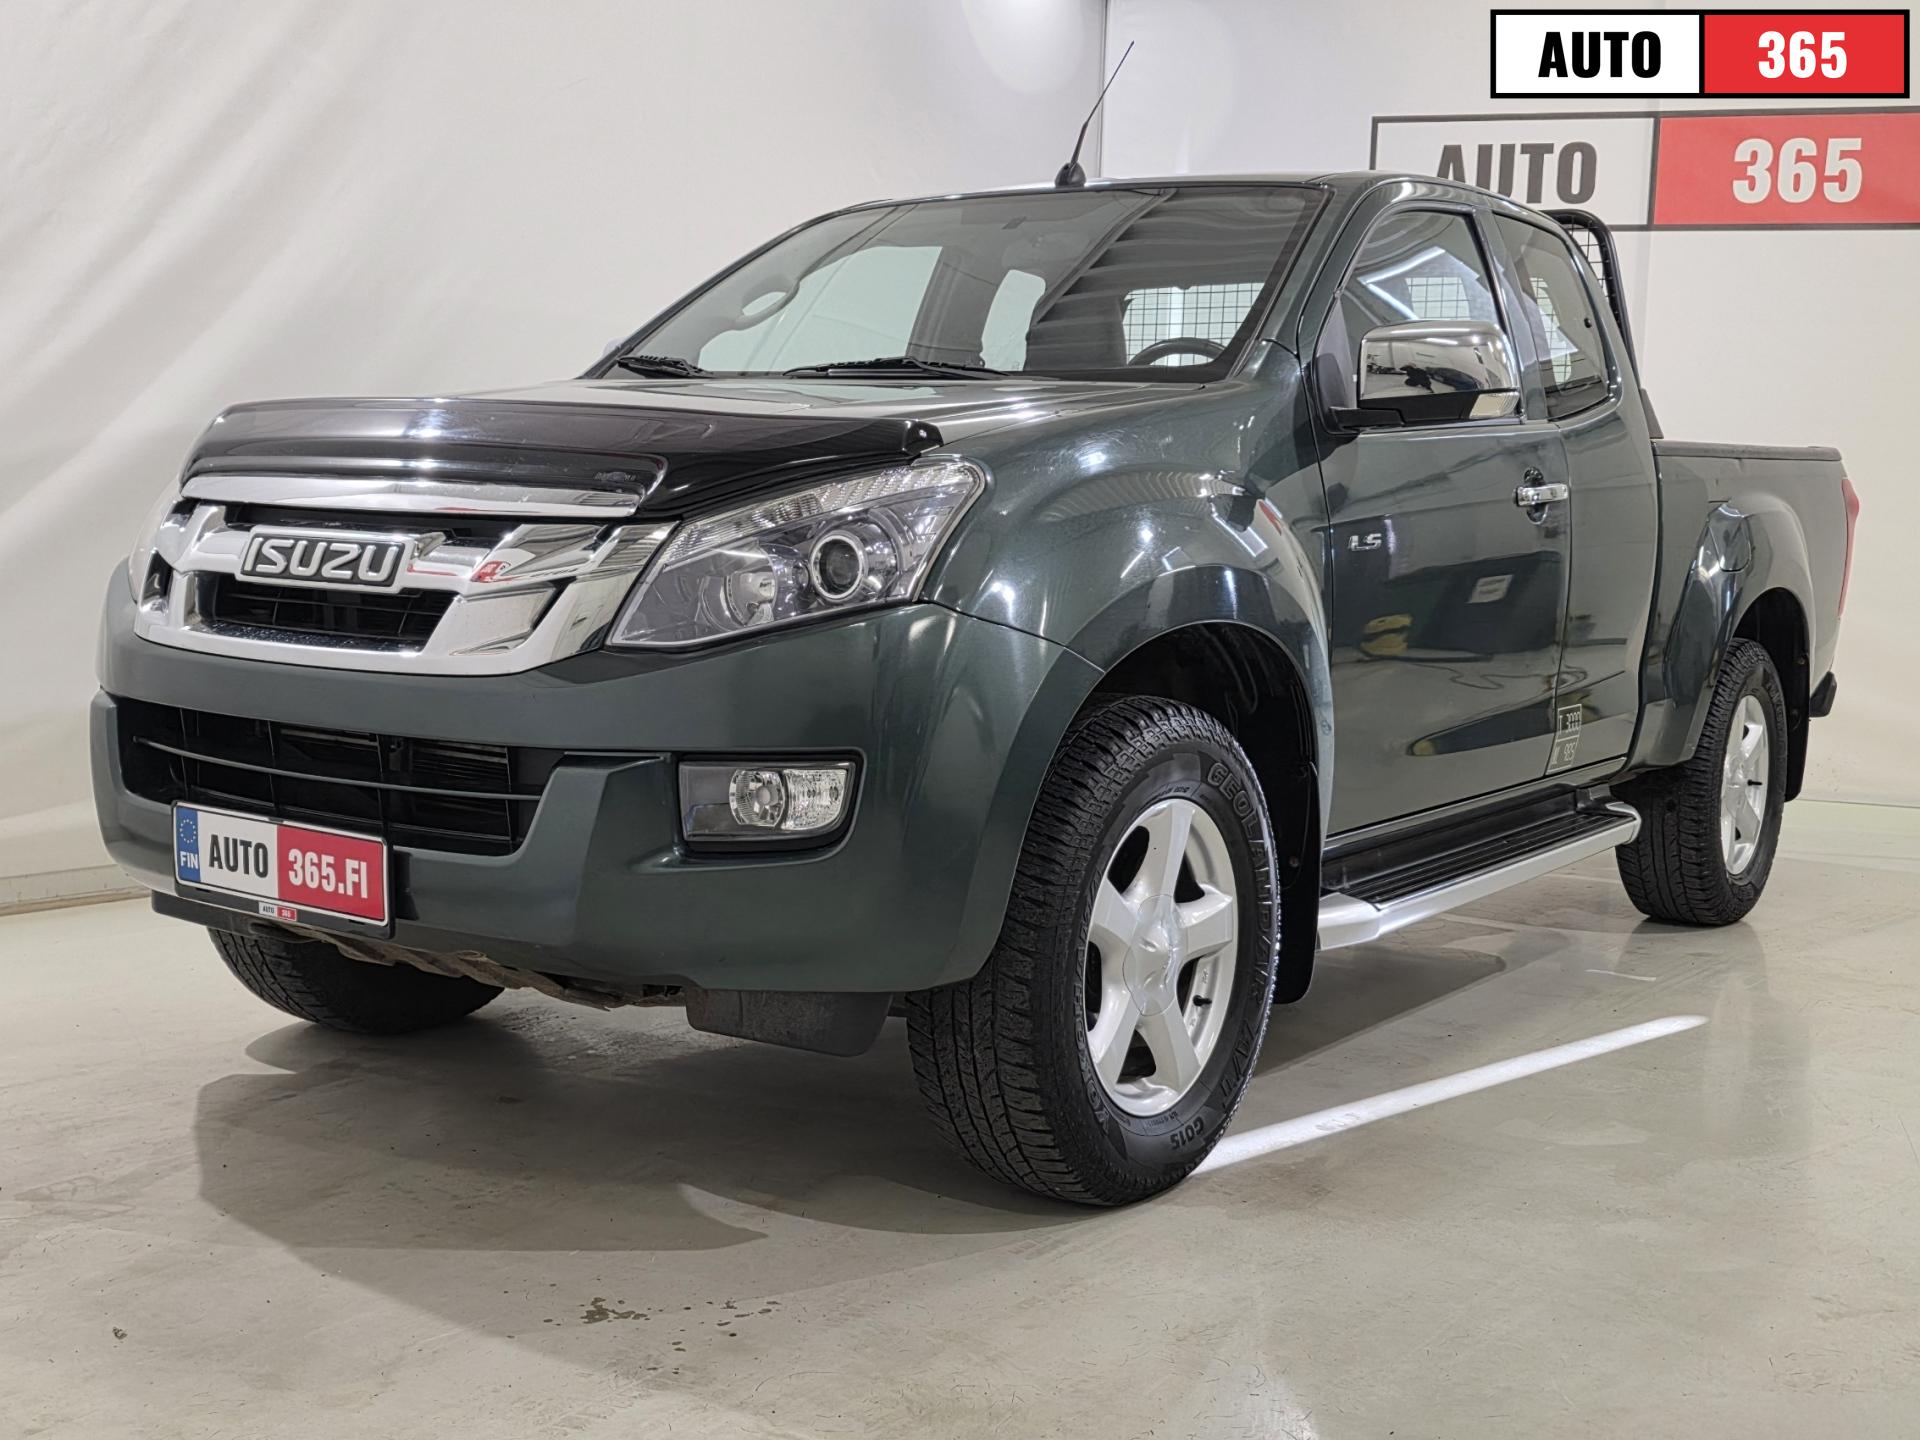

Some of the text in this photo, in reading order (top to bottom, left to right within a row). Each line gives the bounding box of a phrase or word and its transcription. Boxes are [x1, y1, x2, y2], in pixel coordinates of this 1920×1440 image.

[1437, 138, 1863, 204] AUTO 365
[243, 536, 400, 582] ISUZU
[1347, 533, 1382, 551] LS
[180, 834, 368, 898] FIN AUTO 365.FI
